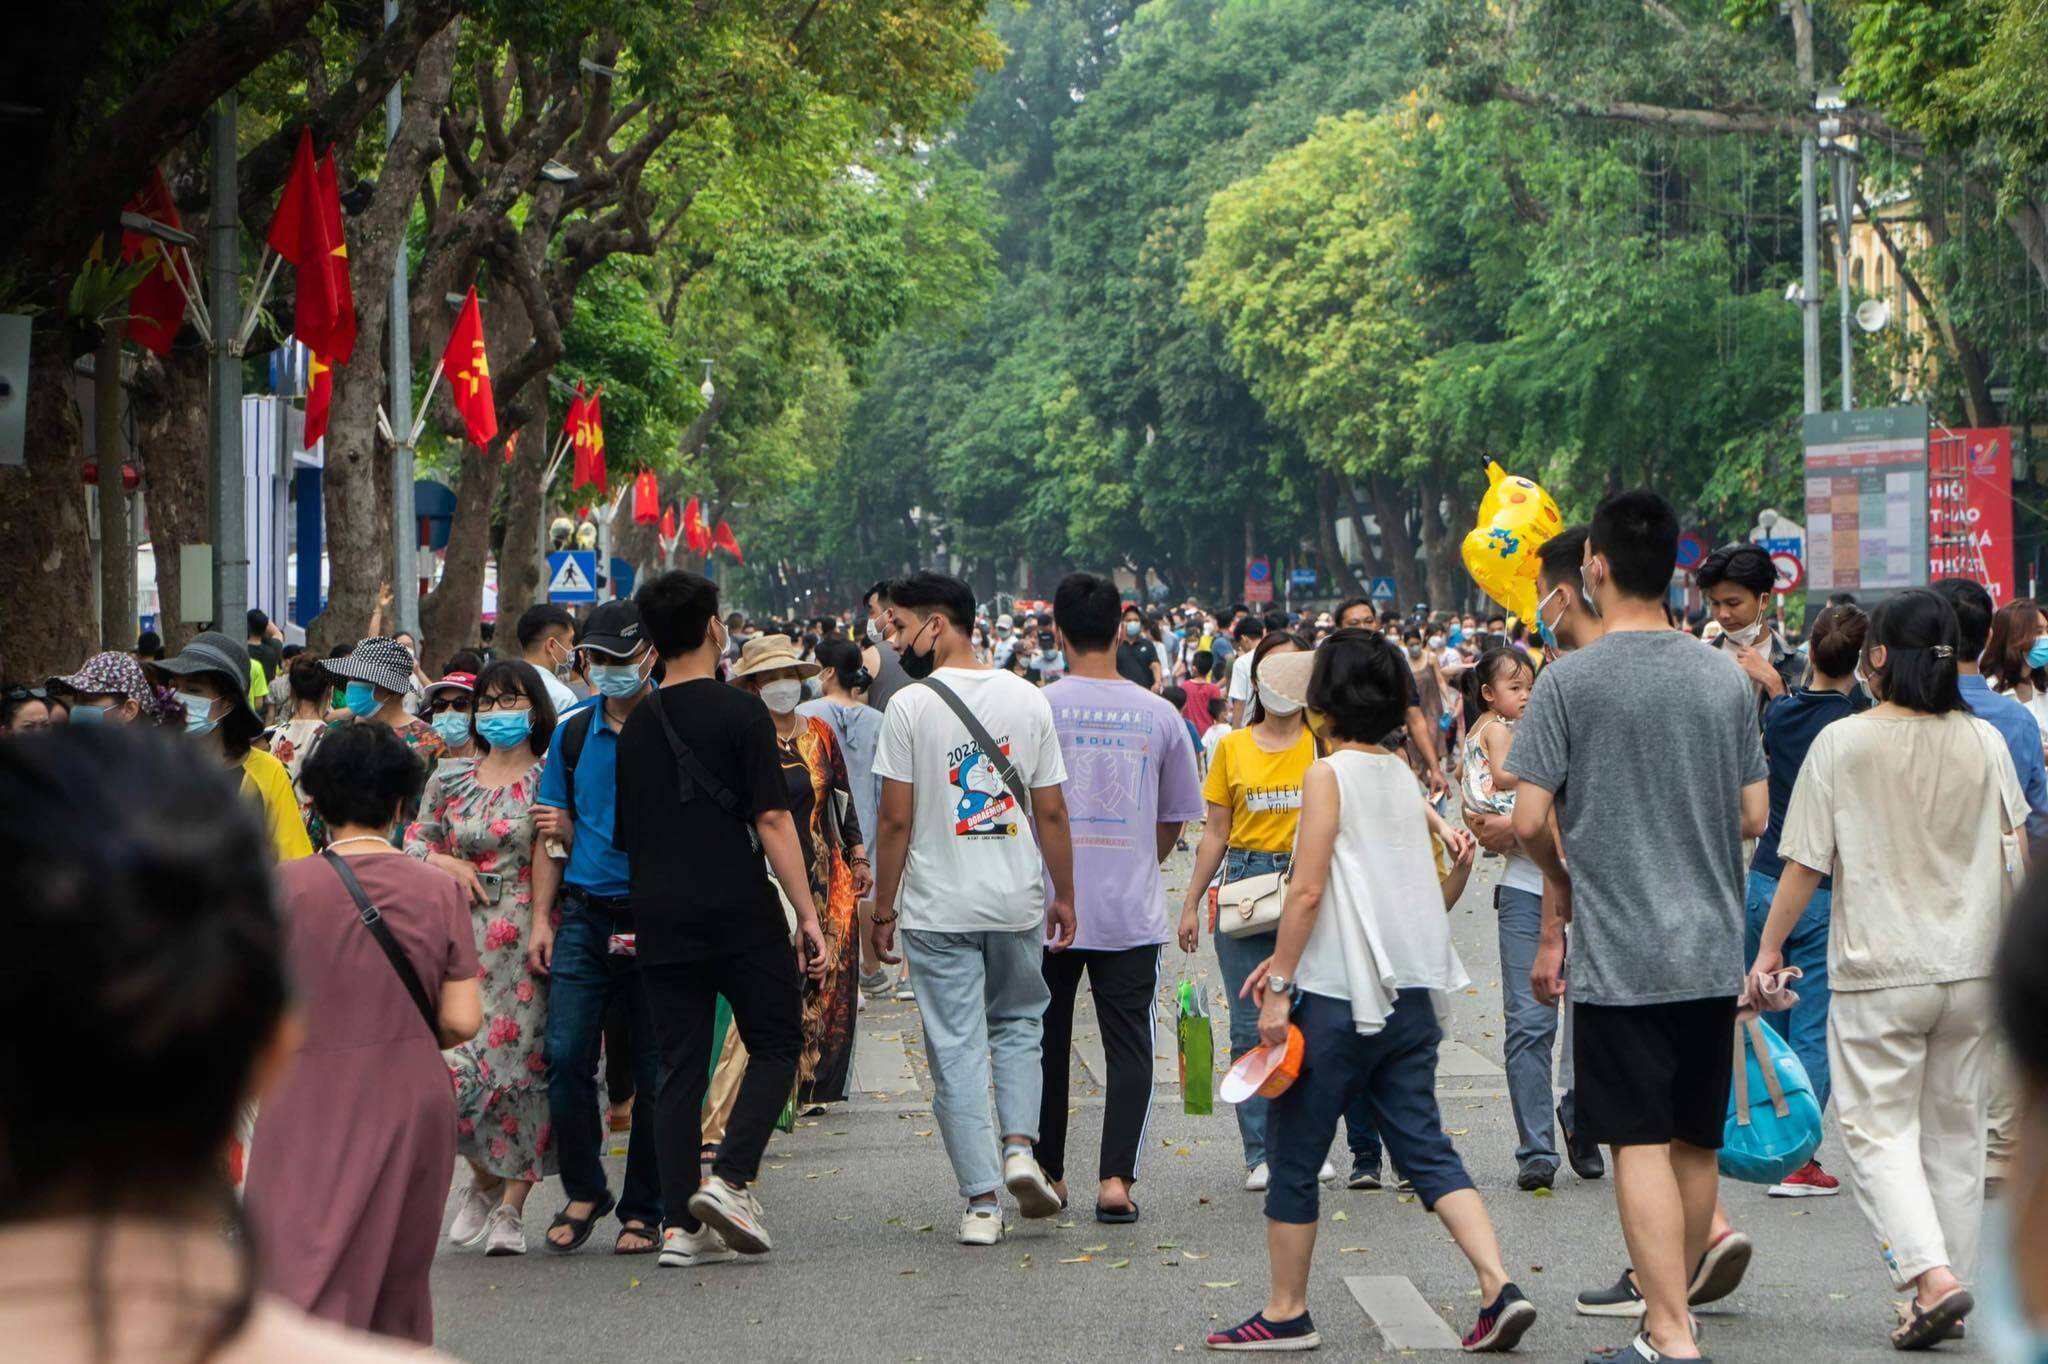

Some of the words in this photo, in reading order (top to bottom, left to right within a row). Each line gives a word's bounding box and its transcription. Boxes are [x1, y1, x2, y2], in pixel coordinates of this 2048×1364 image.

[1075, 736, 1125, 747] SOUL
[947, 740, 978, 767] 2022
[1246, 784, 1299, 801] BELIEV
[966, 801, 1008, 828] DORAEMON
[1268, 802, 1289, 815] YOU
